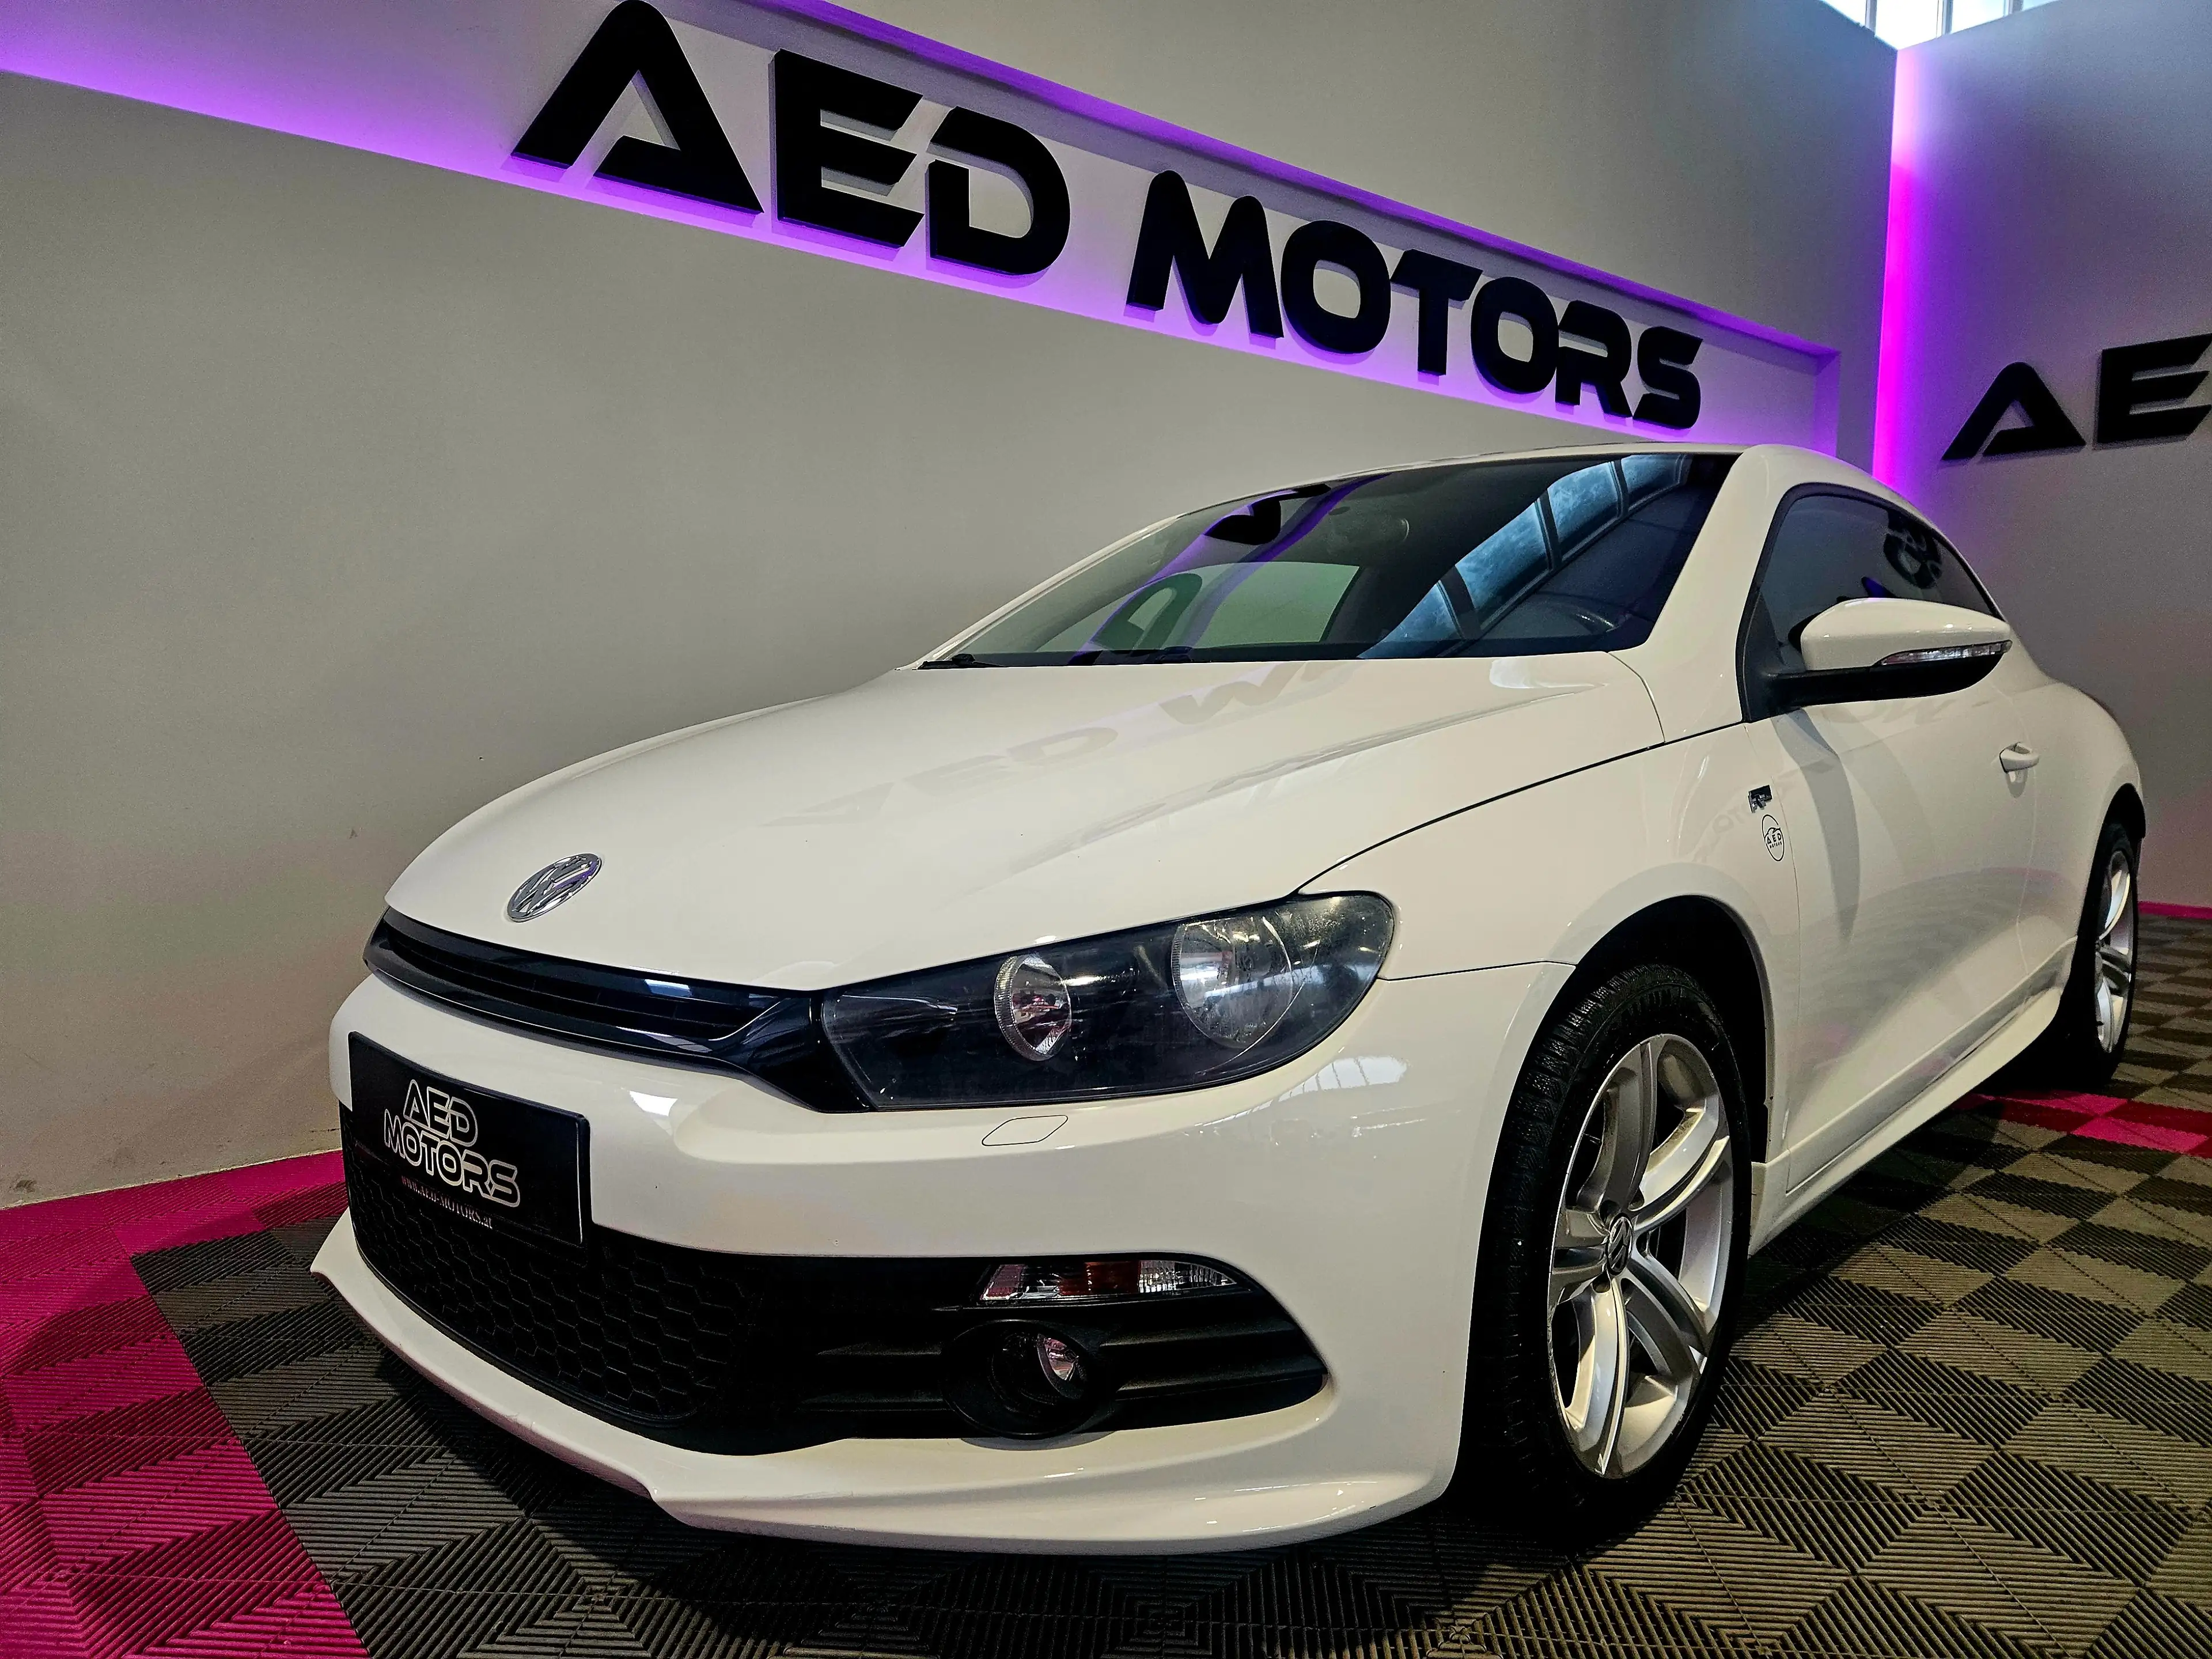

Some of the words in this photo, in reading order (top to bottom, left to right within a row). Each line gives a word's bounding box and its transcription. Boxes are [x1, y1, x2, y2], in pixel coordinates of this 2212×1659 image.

[510, 0, 1070, 275] AED
[1126, 170, 1704, 430] MOTORS
[1767, 832, 1782, 844] AED
[404, 1079, 478, 1147] AED
[384, 1108, 520, 1207] MOTORS
